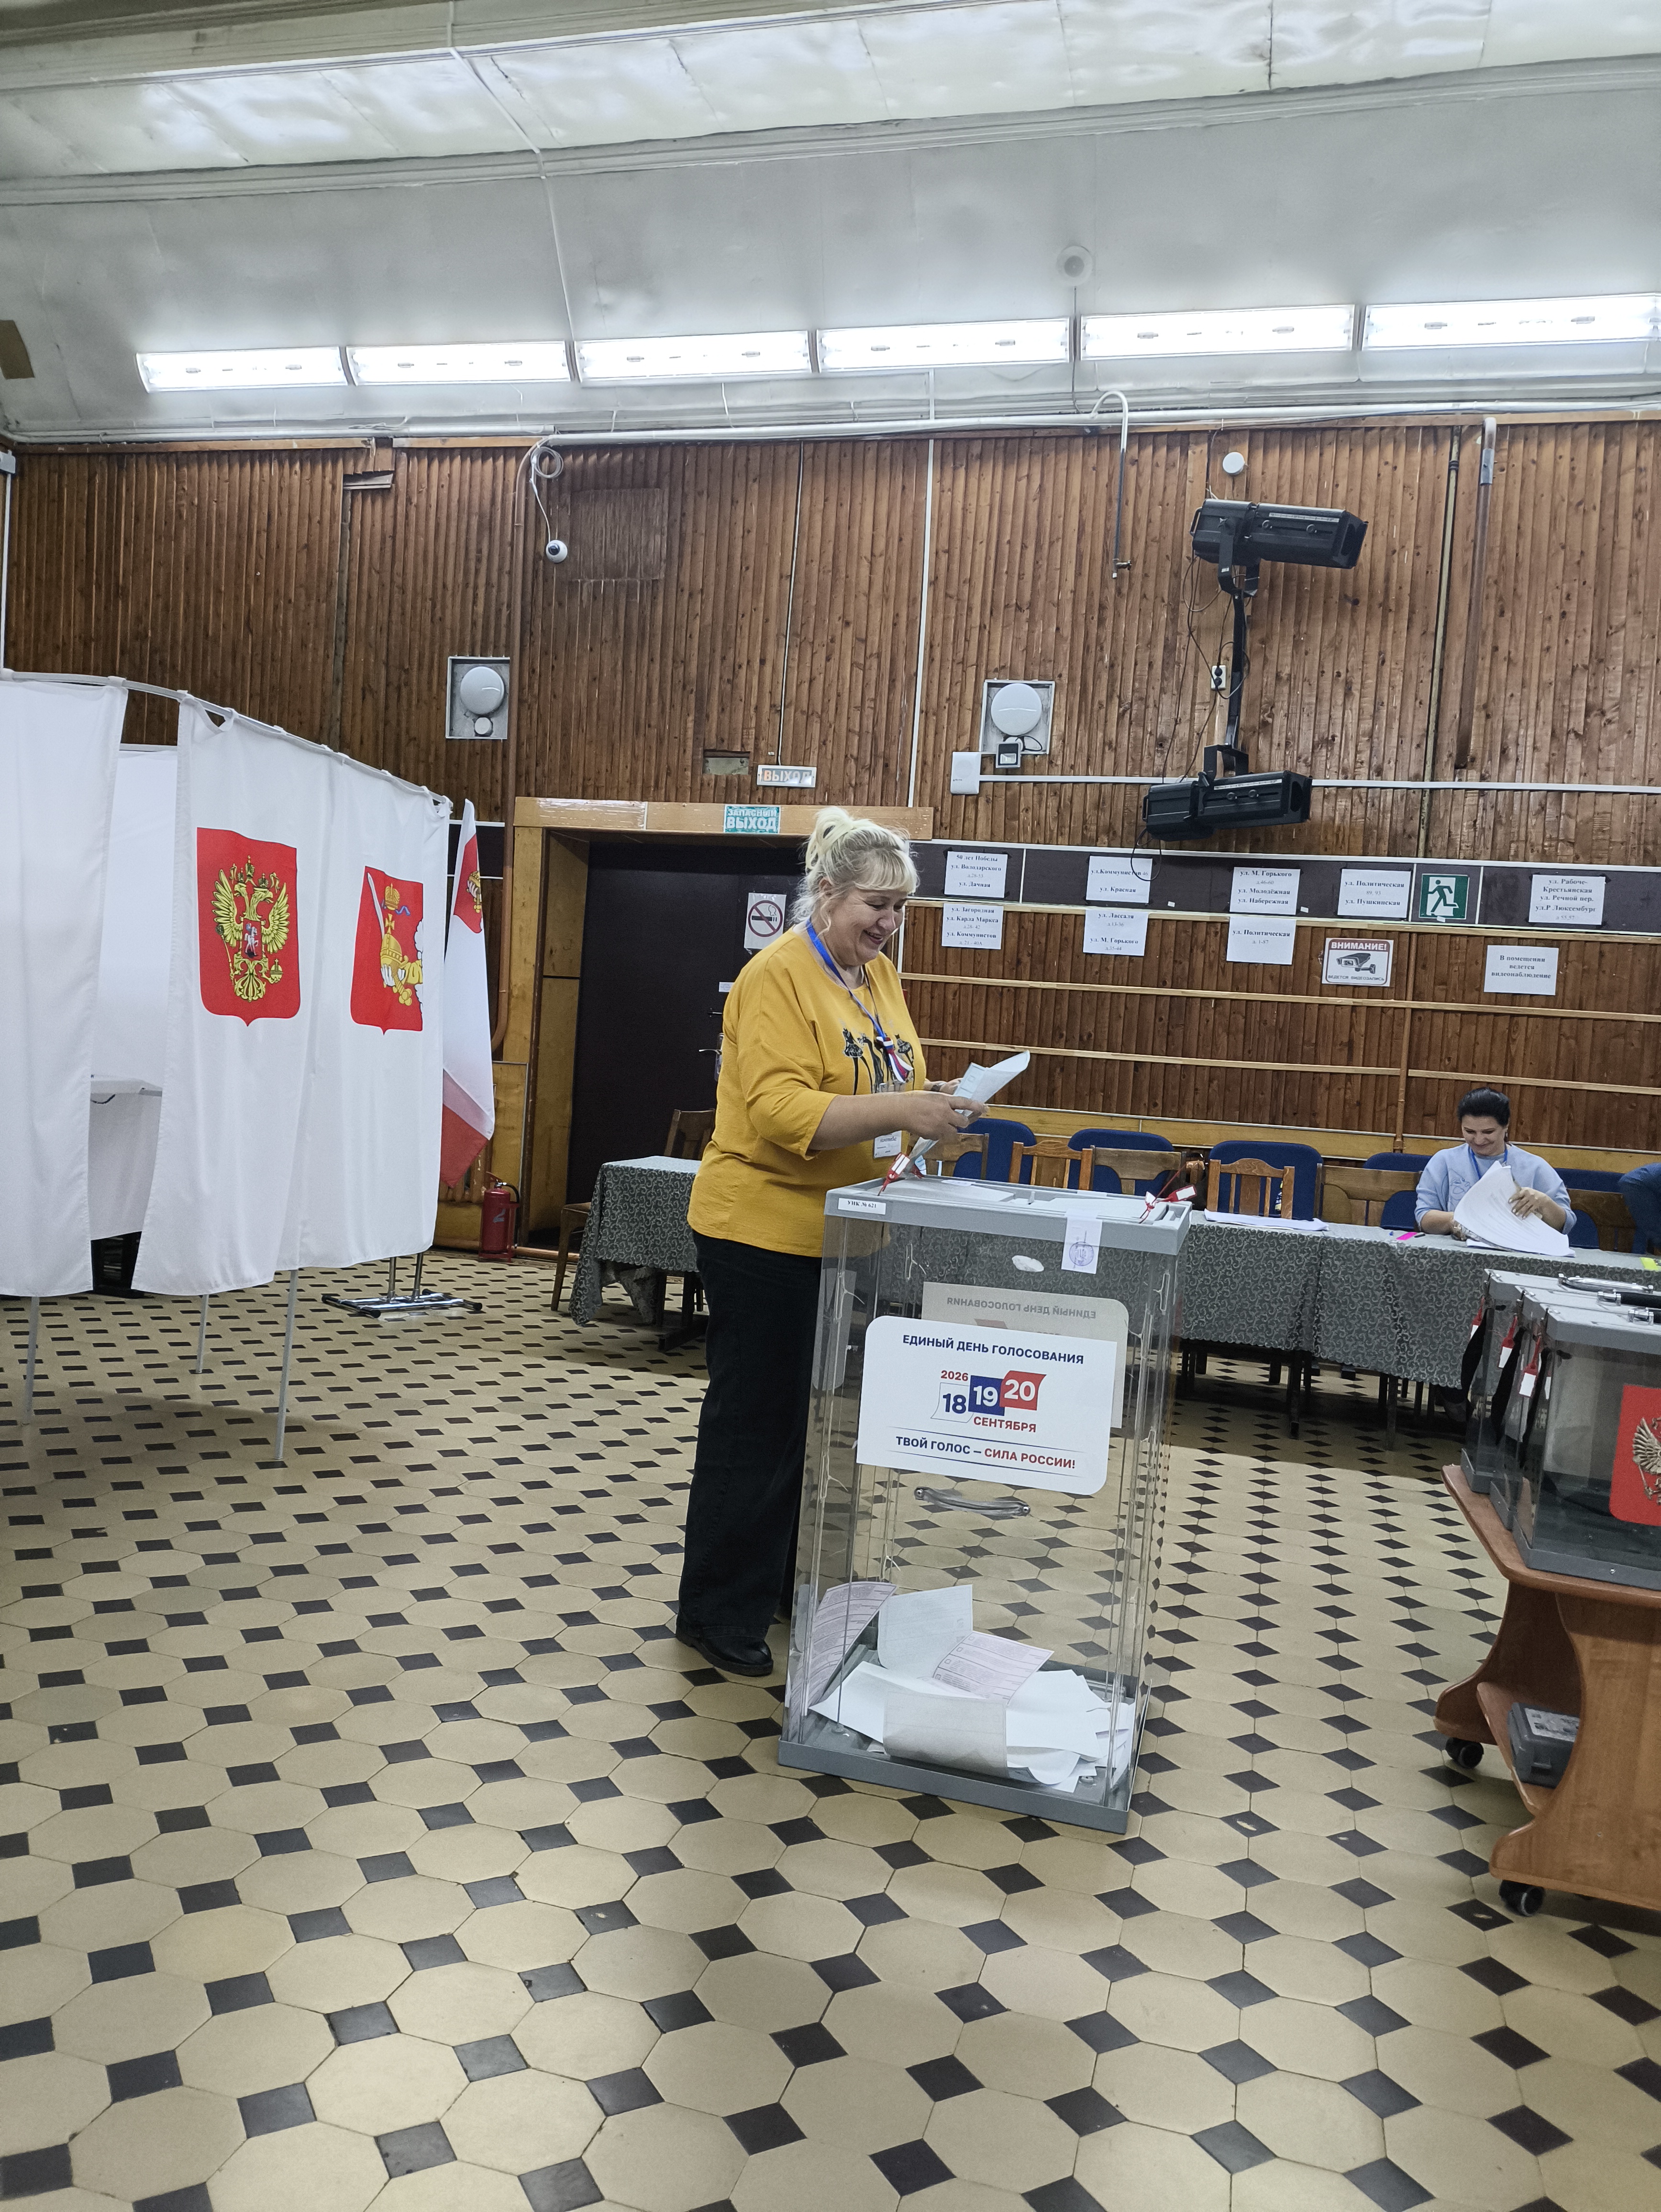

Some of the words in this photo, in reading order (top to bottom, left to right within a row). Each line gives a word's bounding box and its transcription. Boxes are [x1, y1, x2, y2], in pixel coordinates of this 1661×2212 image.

[764, 770, 811, 785] ВЫХОД
[728, 808, 777, 817] ЗАПАСНЫЙ
[727, 817, 776, 832] ВЫХОД
[1331, 942, 1387, 951] ВНИМАНИЕ!
[903, 1335, 954, 1349] ЕДИНЫЙ
[956, 1341, 989, 1353] ДЕНЬ
[992, 1345, 1084, 1364] ГОЛОСОВАНИЯ
[941, 1370, 968, 1382] 2026
[942, 1393, 966, 1414] 18
[974, 1385, 998, 1407] 19
[1004, 1379, 1036, 1401] 20
[974, 1416, 1036, 1433] СЕНТЯБРЯ
[896, 1436, 928, 1449] ТВОЙ
[930, 1440, 971, 1454] ГОЛОС
[984, 1448, 1018, 1461] СИЛА
[1020, 1452, 1075, 1469] РОССИИ!
